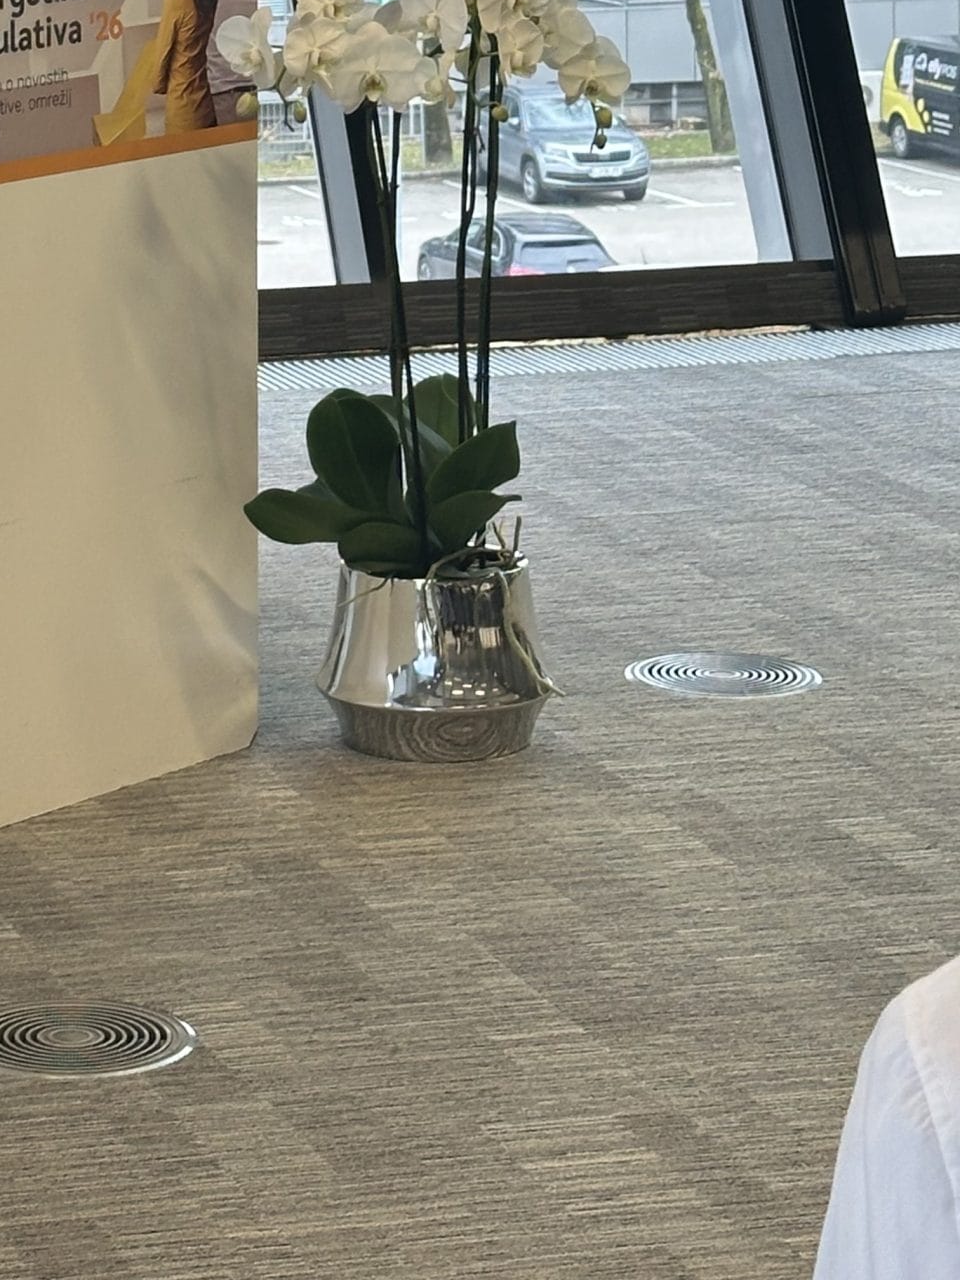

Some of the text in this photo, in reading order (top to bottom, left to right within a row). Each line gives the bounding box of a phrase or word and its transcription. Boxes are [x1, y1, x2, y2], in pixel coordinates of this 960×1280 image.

[90, 9, 124, 41] '26
[5, 79, 14, 92] o
[16, 69, 70, 90] novostih
